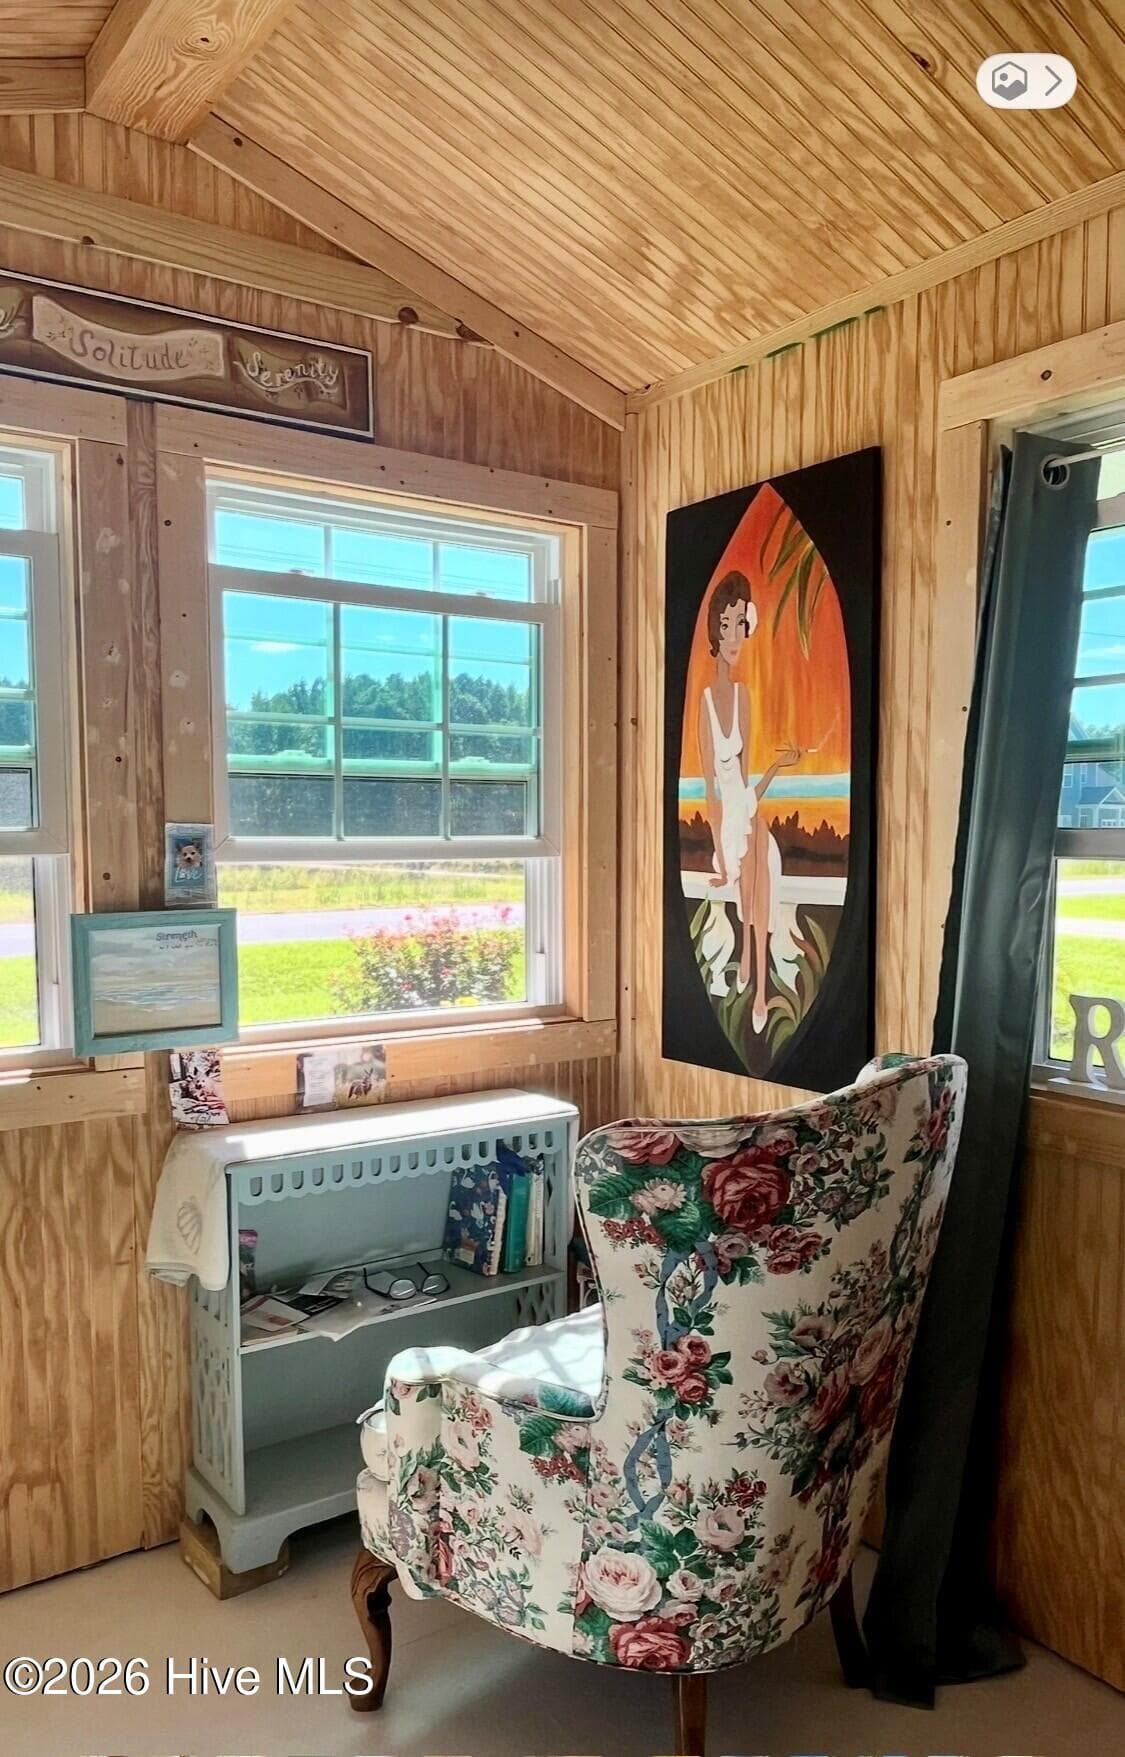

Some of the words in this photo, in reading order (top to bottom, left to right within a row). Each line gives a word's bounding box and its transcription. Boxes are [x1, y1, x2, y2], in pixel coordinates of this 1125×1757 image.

[70, 329, 190, 370] Solitude
[246, 352, 340, 386] Serenity
[1069, 994, 1125, 1090] R
